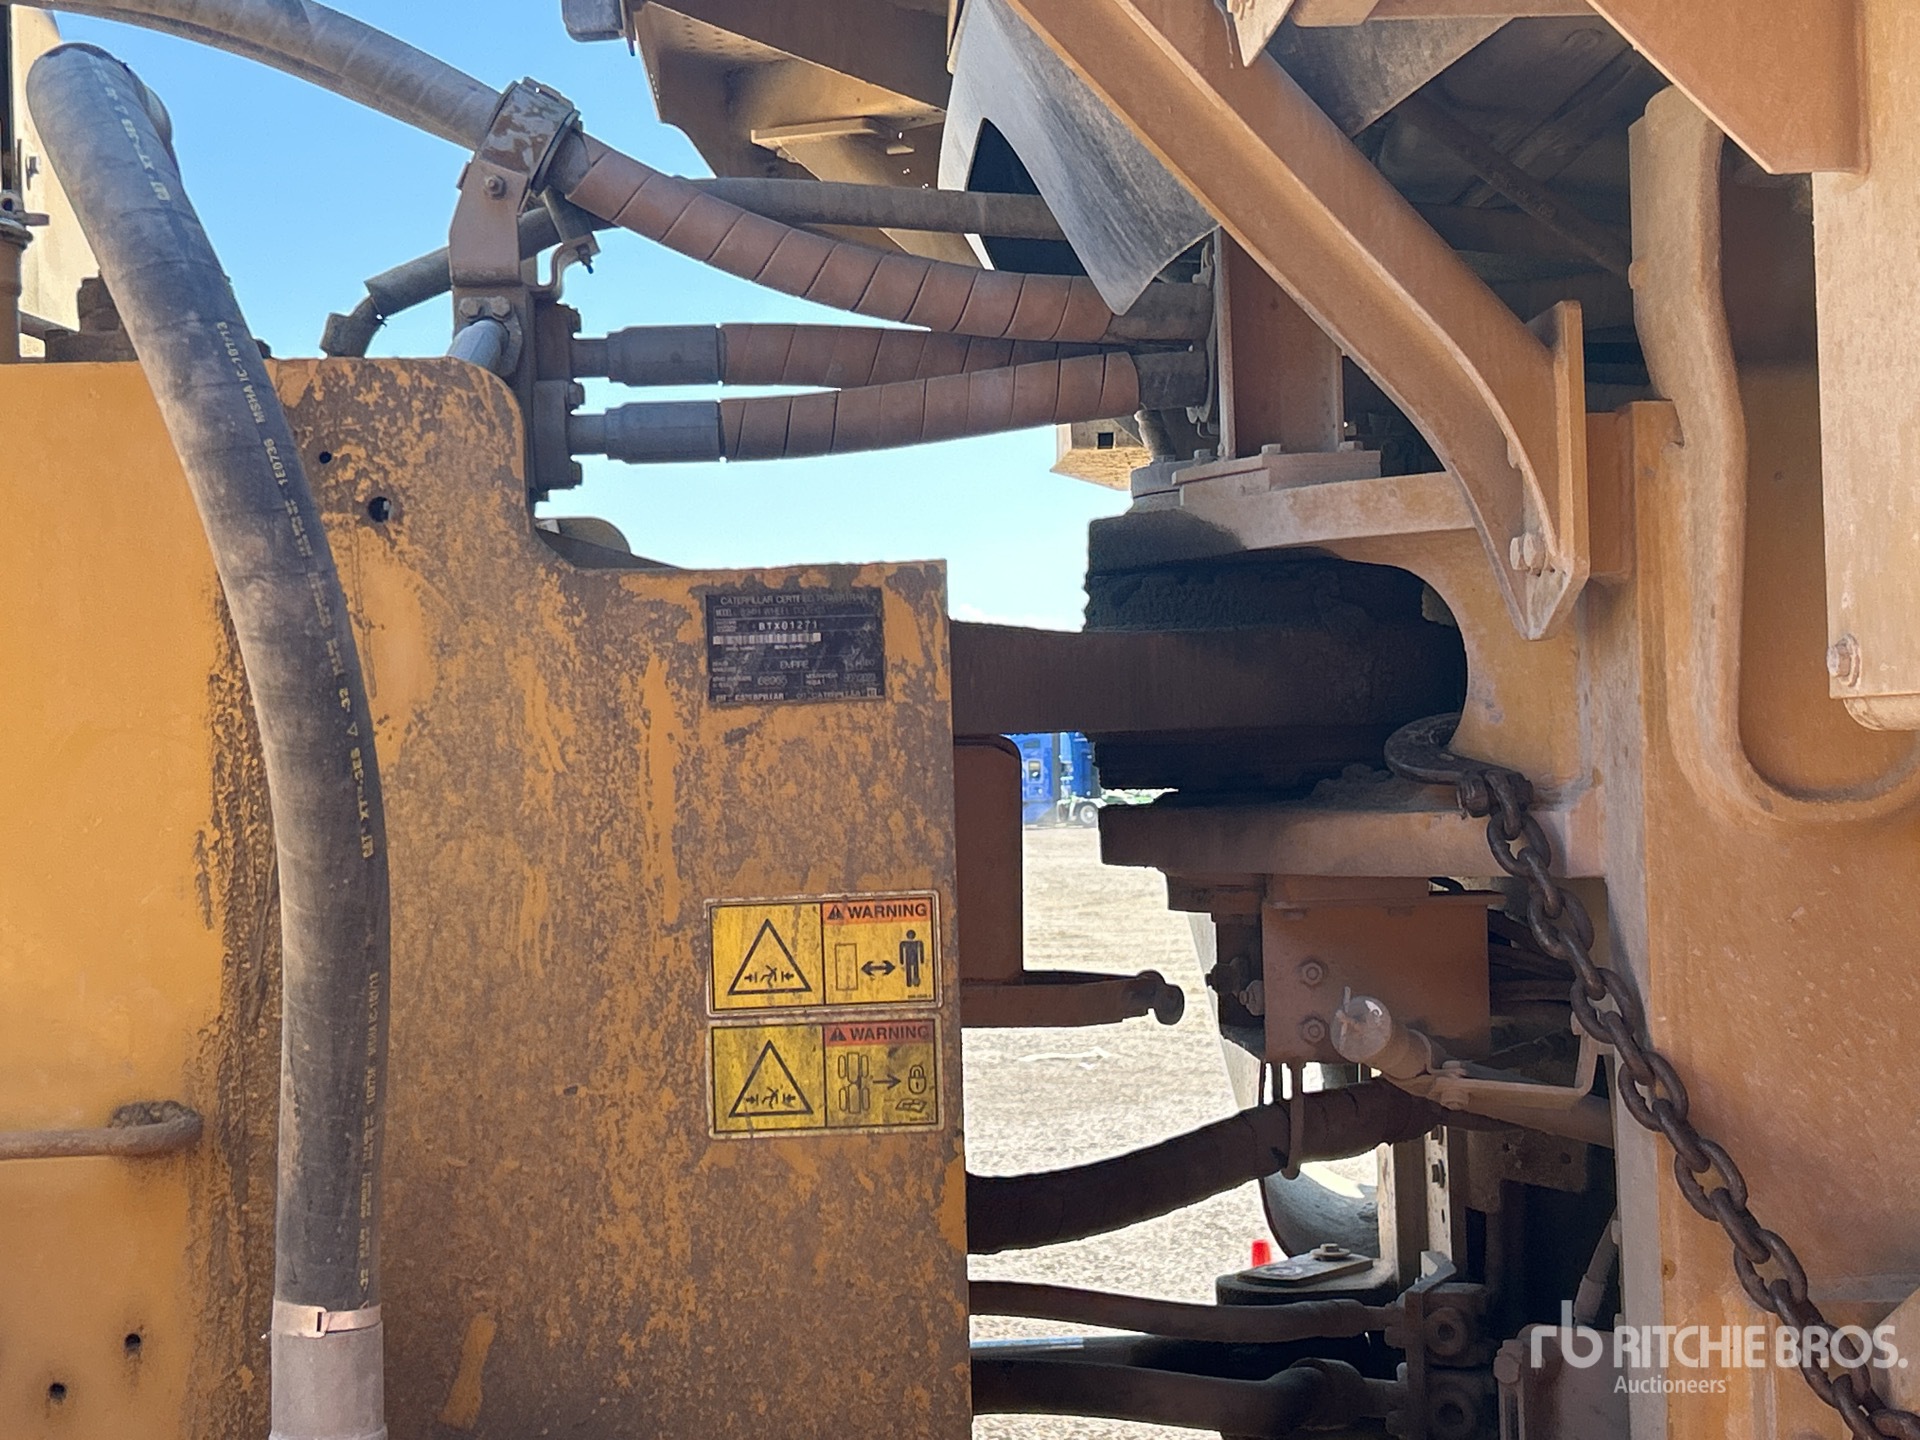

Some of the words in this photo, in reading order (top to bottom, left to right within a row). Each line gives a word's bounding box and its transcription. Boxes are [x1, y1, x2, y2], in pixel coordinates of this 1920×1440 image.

[242, 384, 266, 424] MSHA
[720, 594, 774, 606] CATERPILLAR
[847, 903, 927, 919] WARNING
[850, 1025, 929, 1041] WARNING
